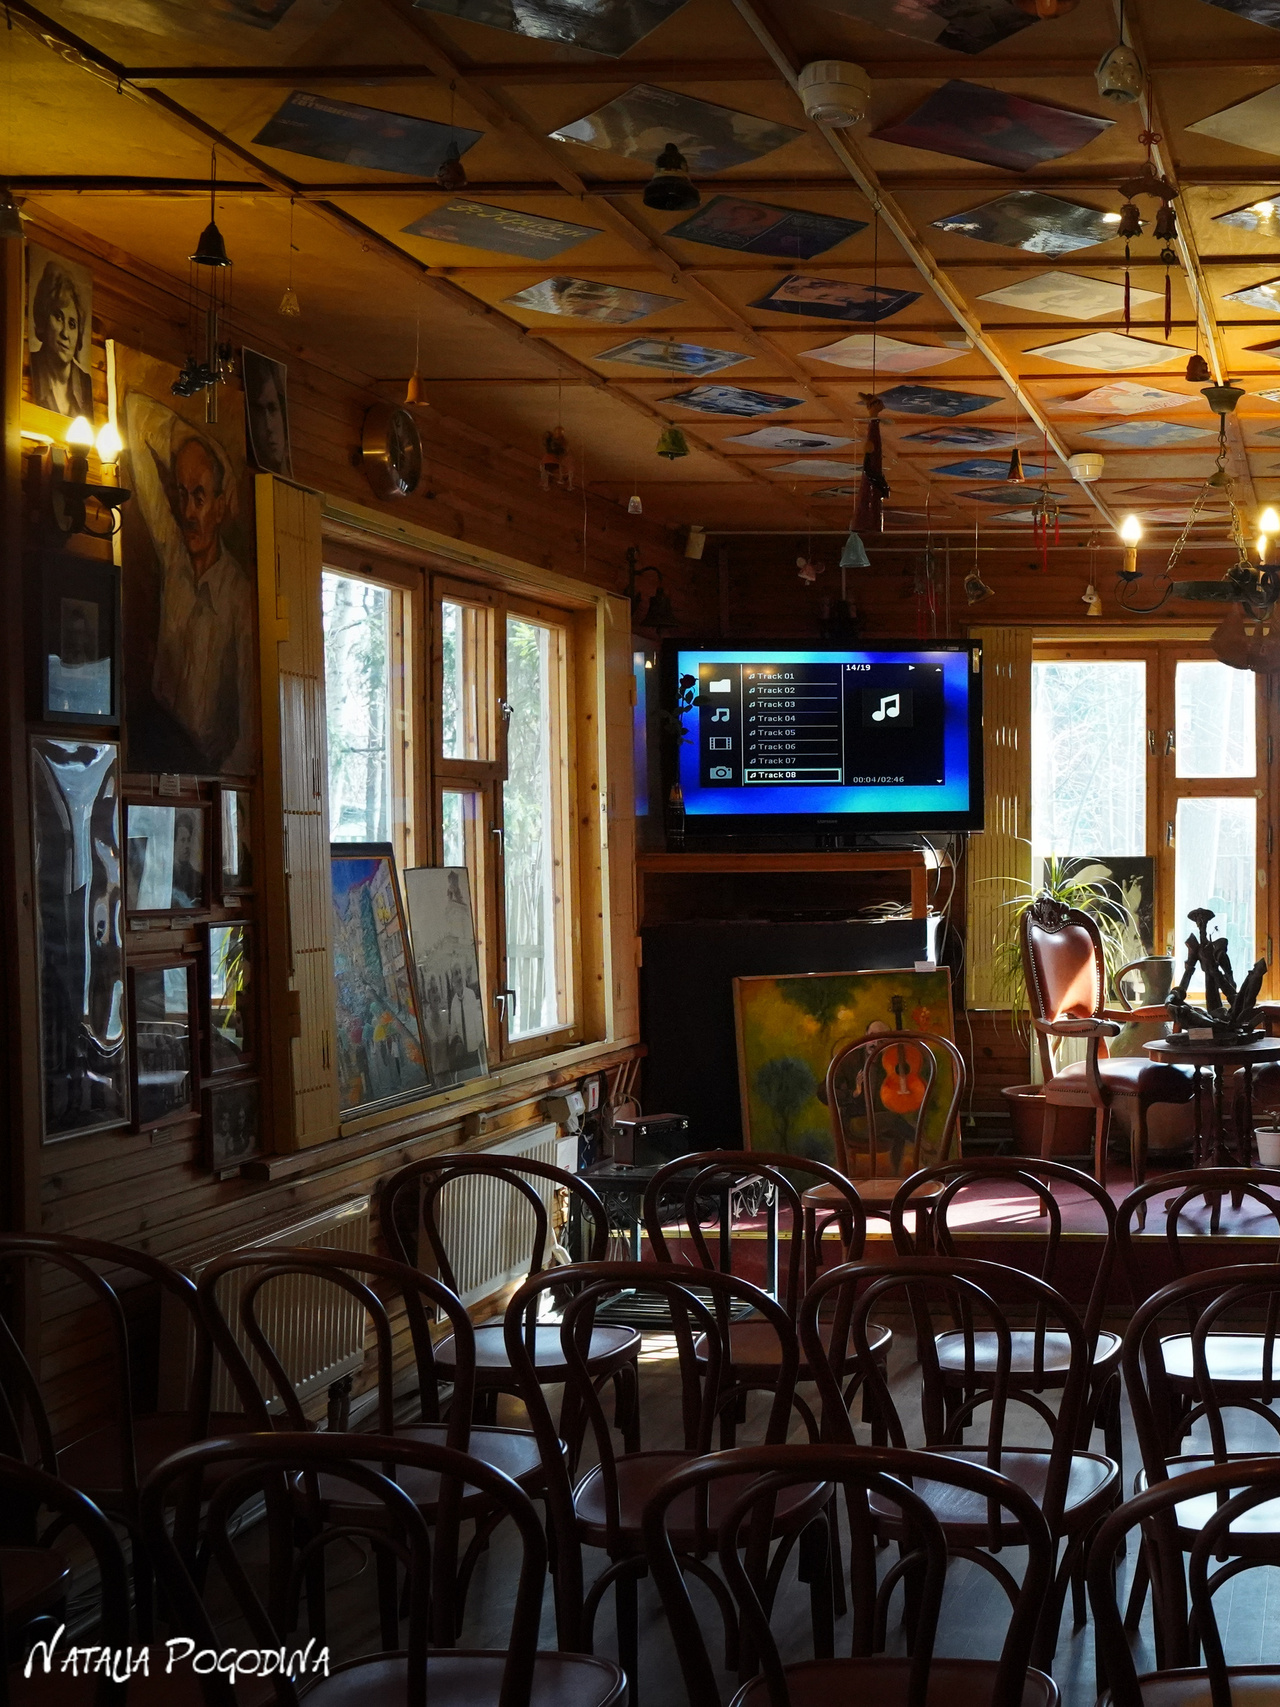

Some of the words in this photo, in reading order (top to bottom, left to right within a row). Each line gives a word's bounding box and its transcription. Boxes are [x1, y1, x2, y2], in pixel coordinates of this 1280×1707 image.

[845, 663, 872, 672] 14/19
[757, 672, 783, 680] Track
[784, 672, 796, 680] 01
[757, 686, 783, 694] Track
[784, 686, 796, 694] 02
[757, 700, 783, 708] Track
[784, 700, 796, 708] 03
[758, 714, 783, 723] Track
[784, 714, 796, 723] 04
[758, 729, 783, 737] Track
[784, 729, 796, 737] 05
[758, 743, 783, 751] Track
[784, 743, 796, 751] 06
[758, 757, 783, 765] Track
[784, 757, 796, 765] 07
[758, 771, 783, 779] Track
[784, 771, 796, 779] 08
[852, 775, 905, 784] 00:04/02:46
